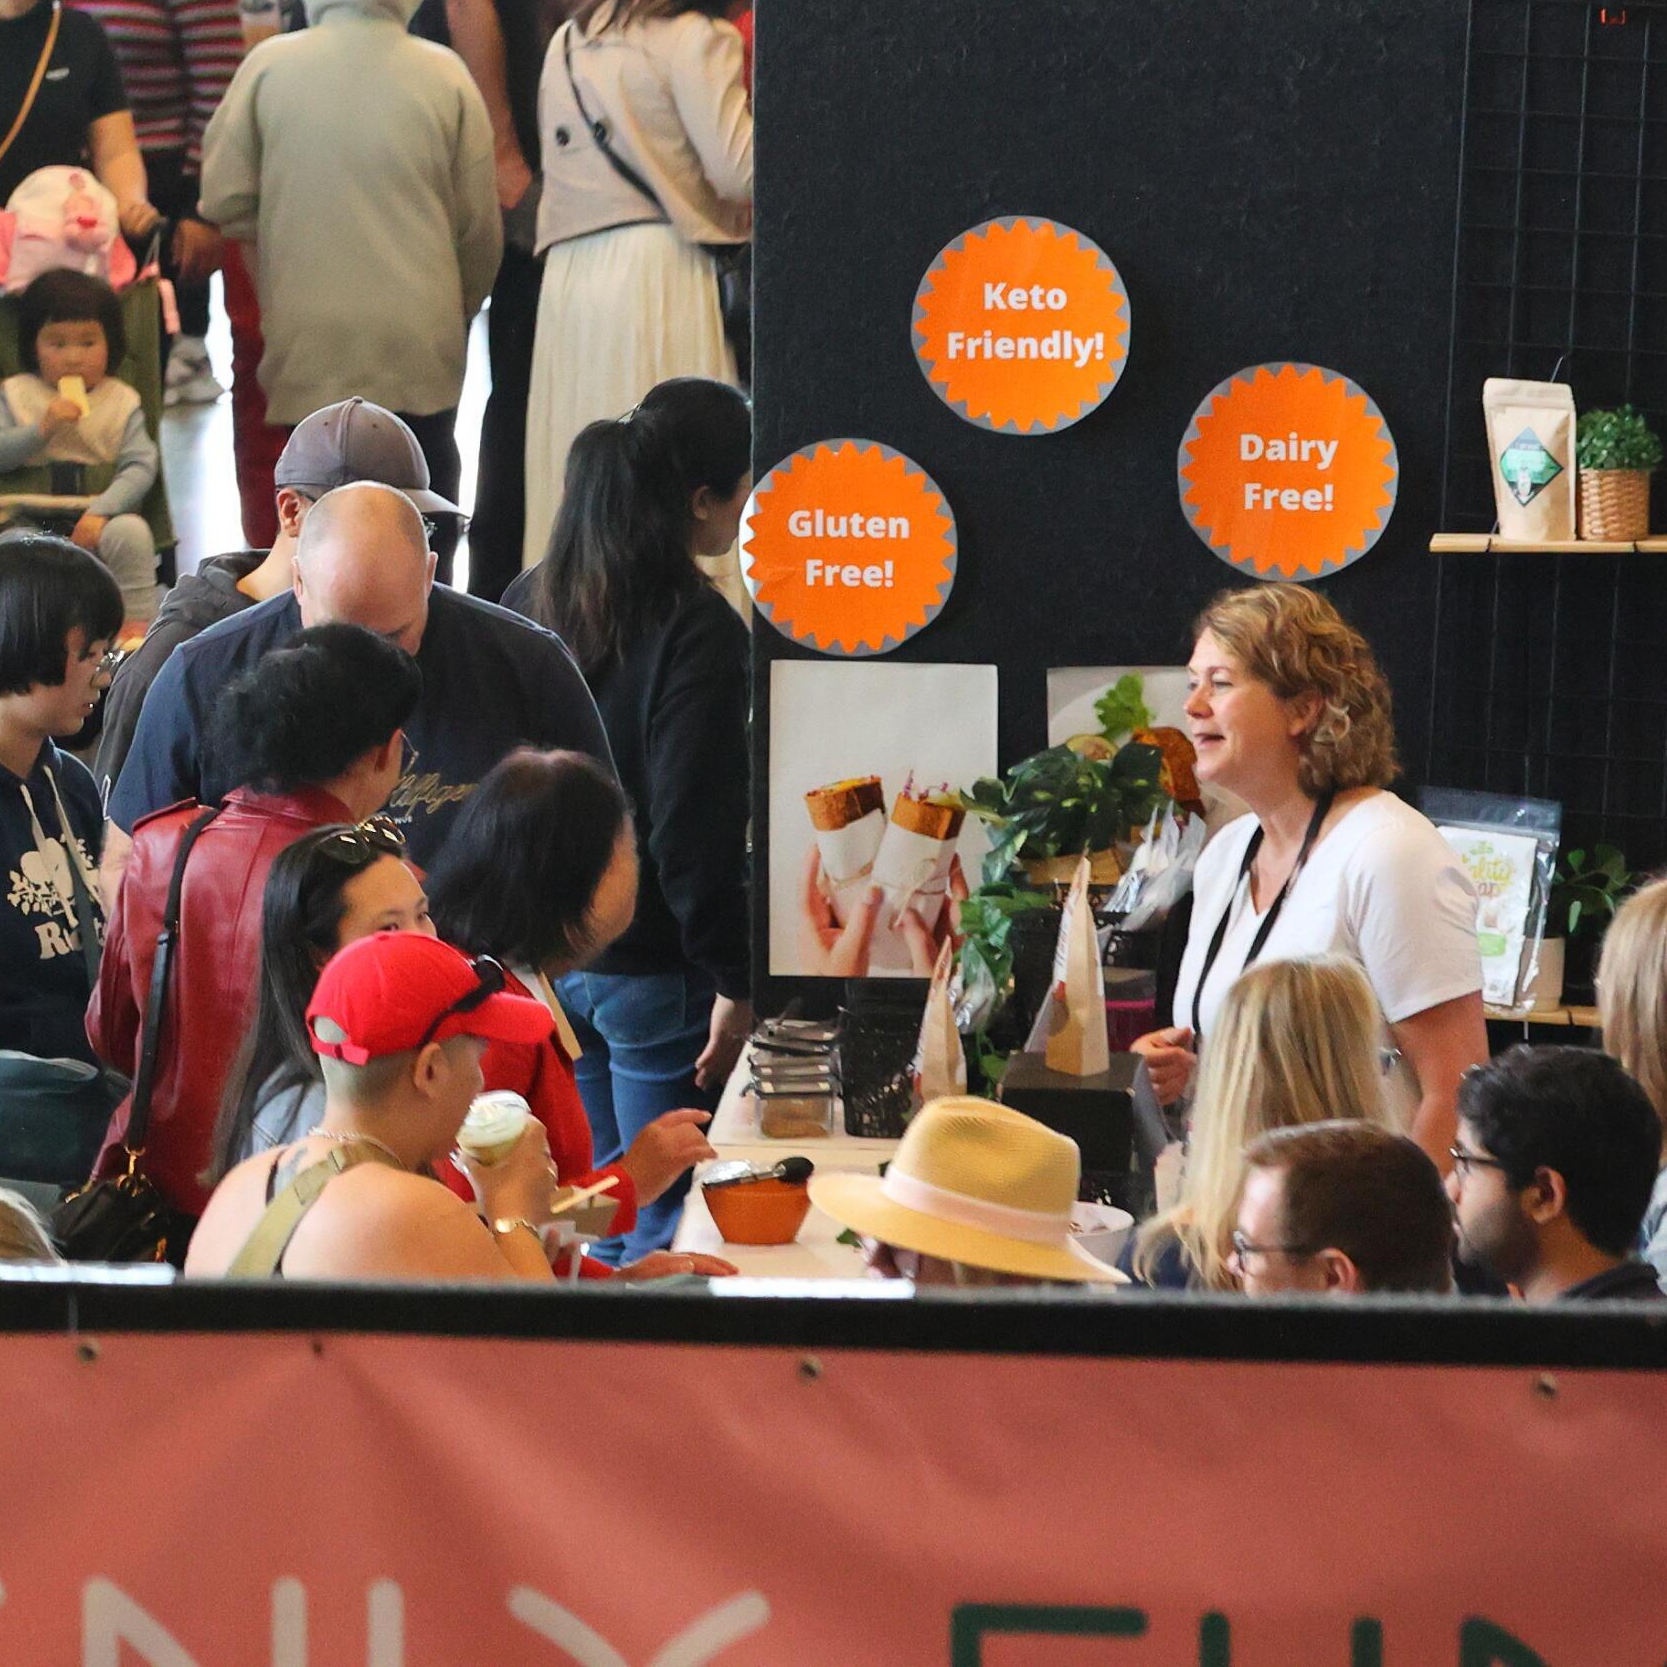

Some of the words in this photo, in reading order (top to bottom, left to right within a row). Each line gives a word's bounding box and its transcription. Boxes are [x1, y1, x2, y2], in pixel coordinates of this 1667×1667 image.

[983, 282, 1068, 311] Keto
[946, 330, 1105, 368] Friendly!
[1239, 432, 1338, 469] Dairy
[1243, 482, 1334, 511] Free!
[788, 508, 910, 540] Gluten
[805, 558, 894, 587] Free!
